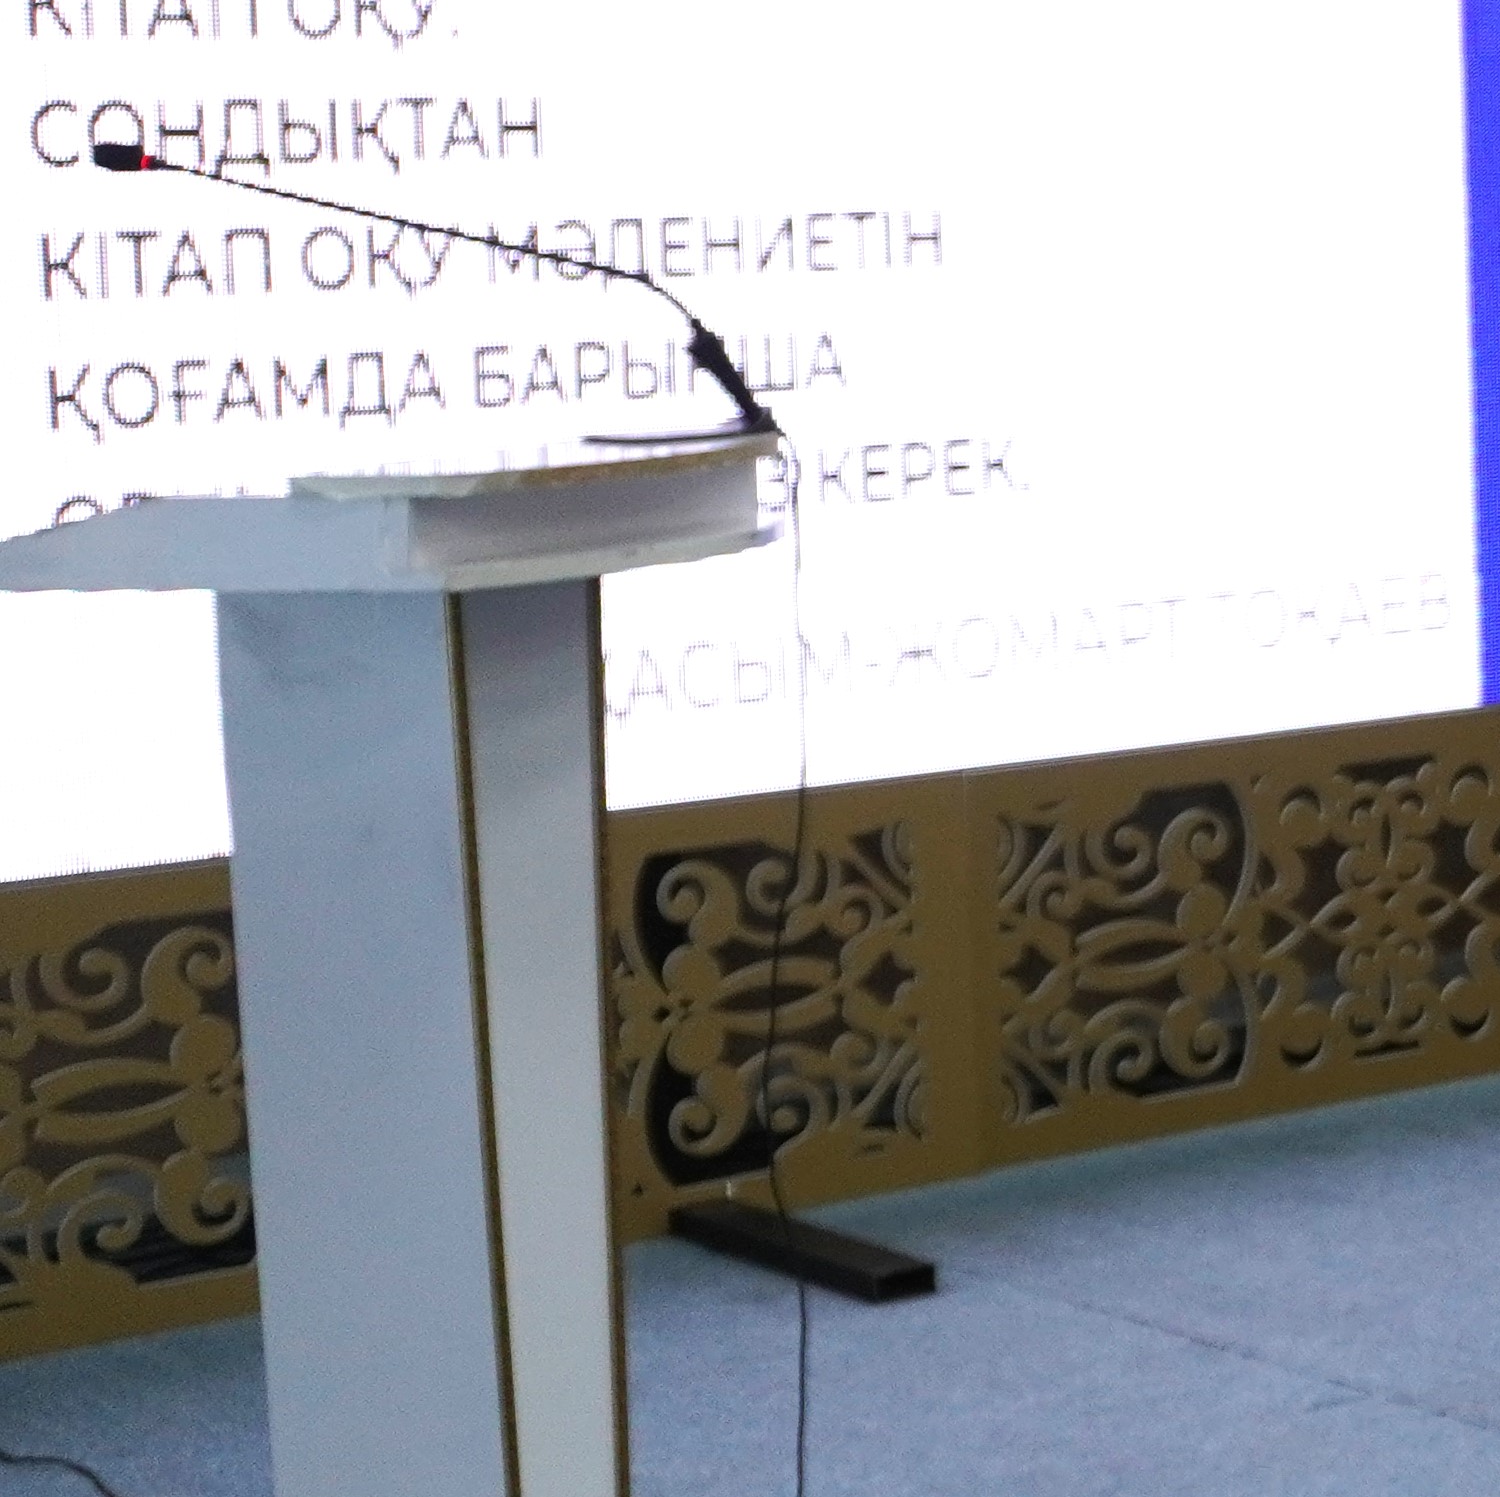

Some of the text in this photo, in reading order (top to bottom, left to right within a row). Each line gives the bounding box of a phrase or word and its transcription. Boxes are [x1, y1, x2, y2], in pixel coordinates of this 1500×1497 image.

[31, 97, 539, 178] СОНДЫҚТАН
[41, 227, 272, 299] КІТАП
[486, 211, 943, 293] МӘДЕНИЕТІН
[48, 331, 842, 442] ҚОҒАМДА БАРЫША
[602, 598, 1184, 722] АСЫМ-ЖОМАРТ
